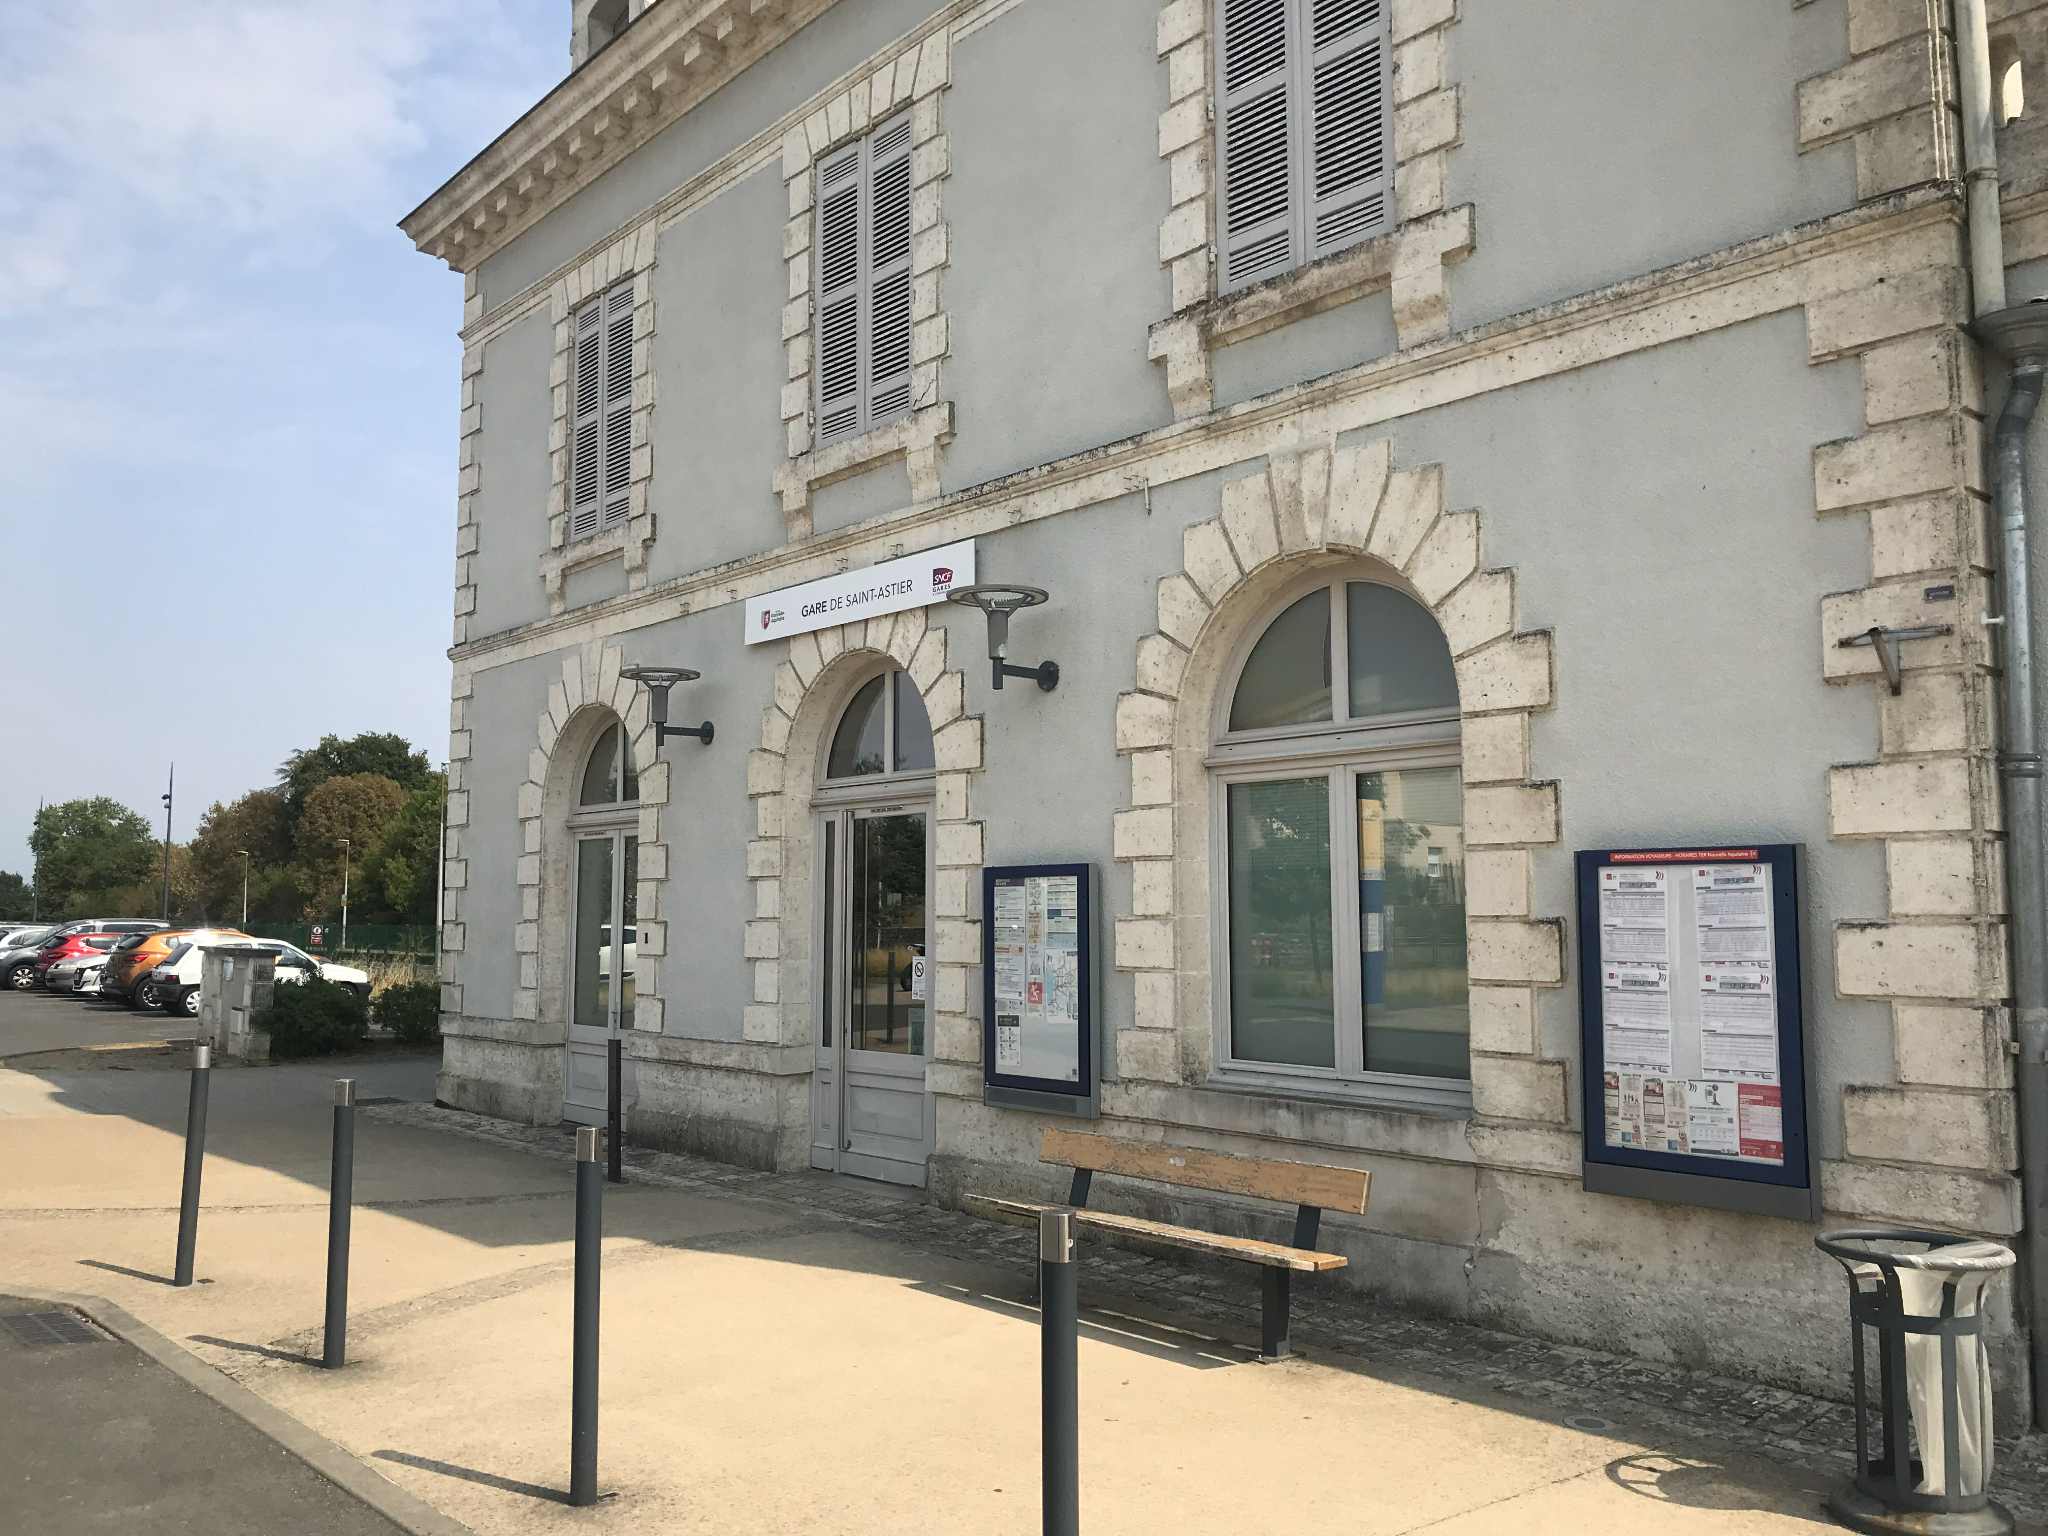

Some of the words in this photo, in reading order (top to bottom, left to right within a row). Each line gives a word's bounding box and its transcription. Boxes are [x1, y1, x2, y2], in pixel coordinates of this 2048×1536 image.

[934, 571, 952, 584] SNCF
[801, 600, 828, 618] GARE
[830, 596, 844, 612] DE
[845, 579, 914, 608] SAINT-ASTIER
